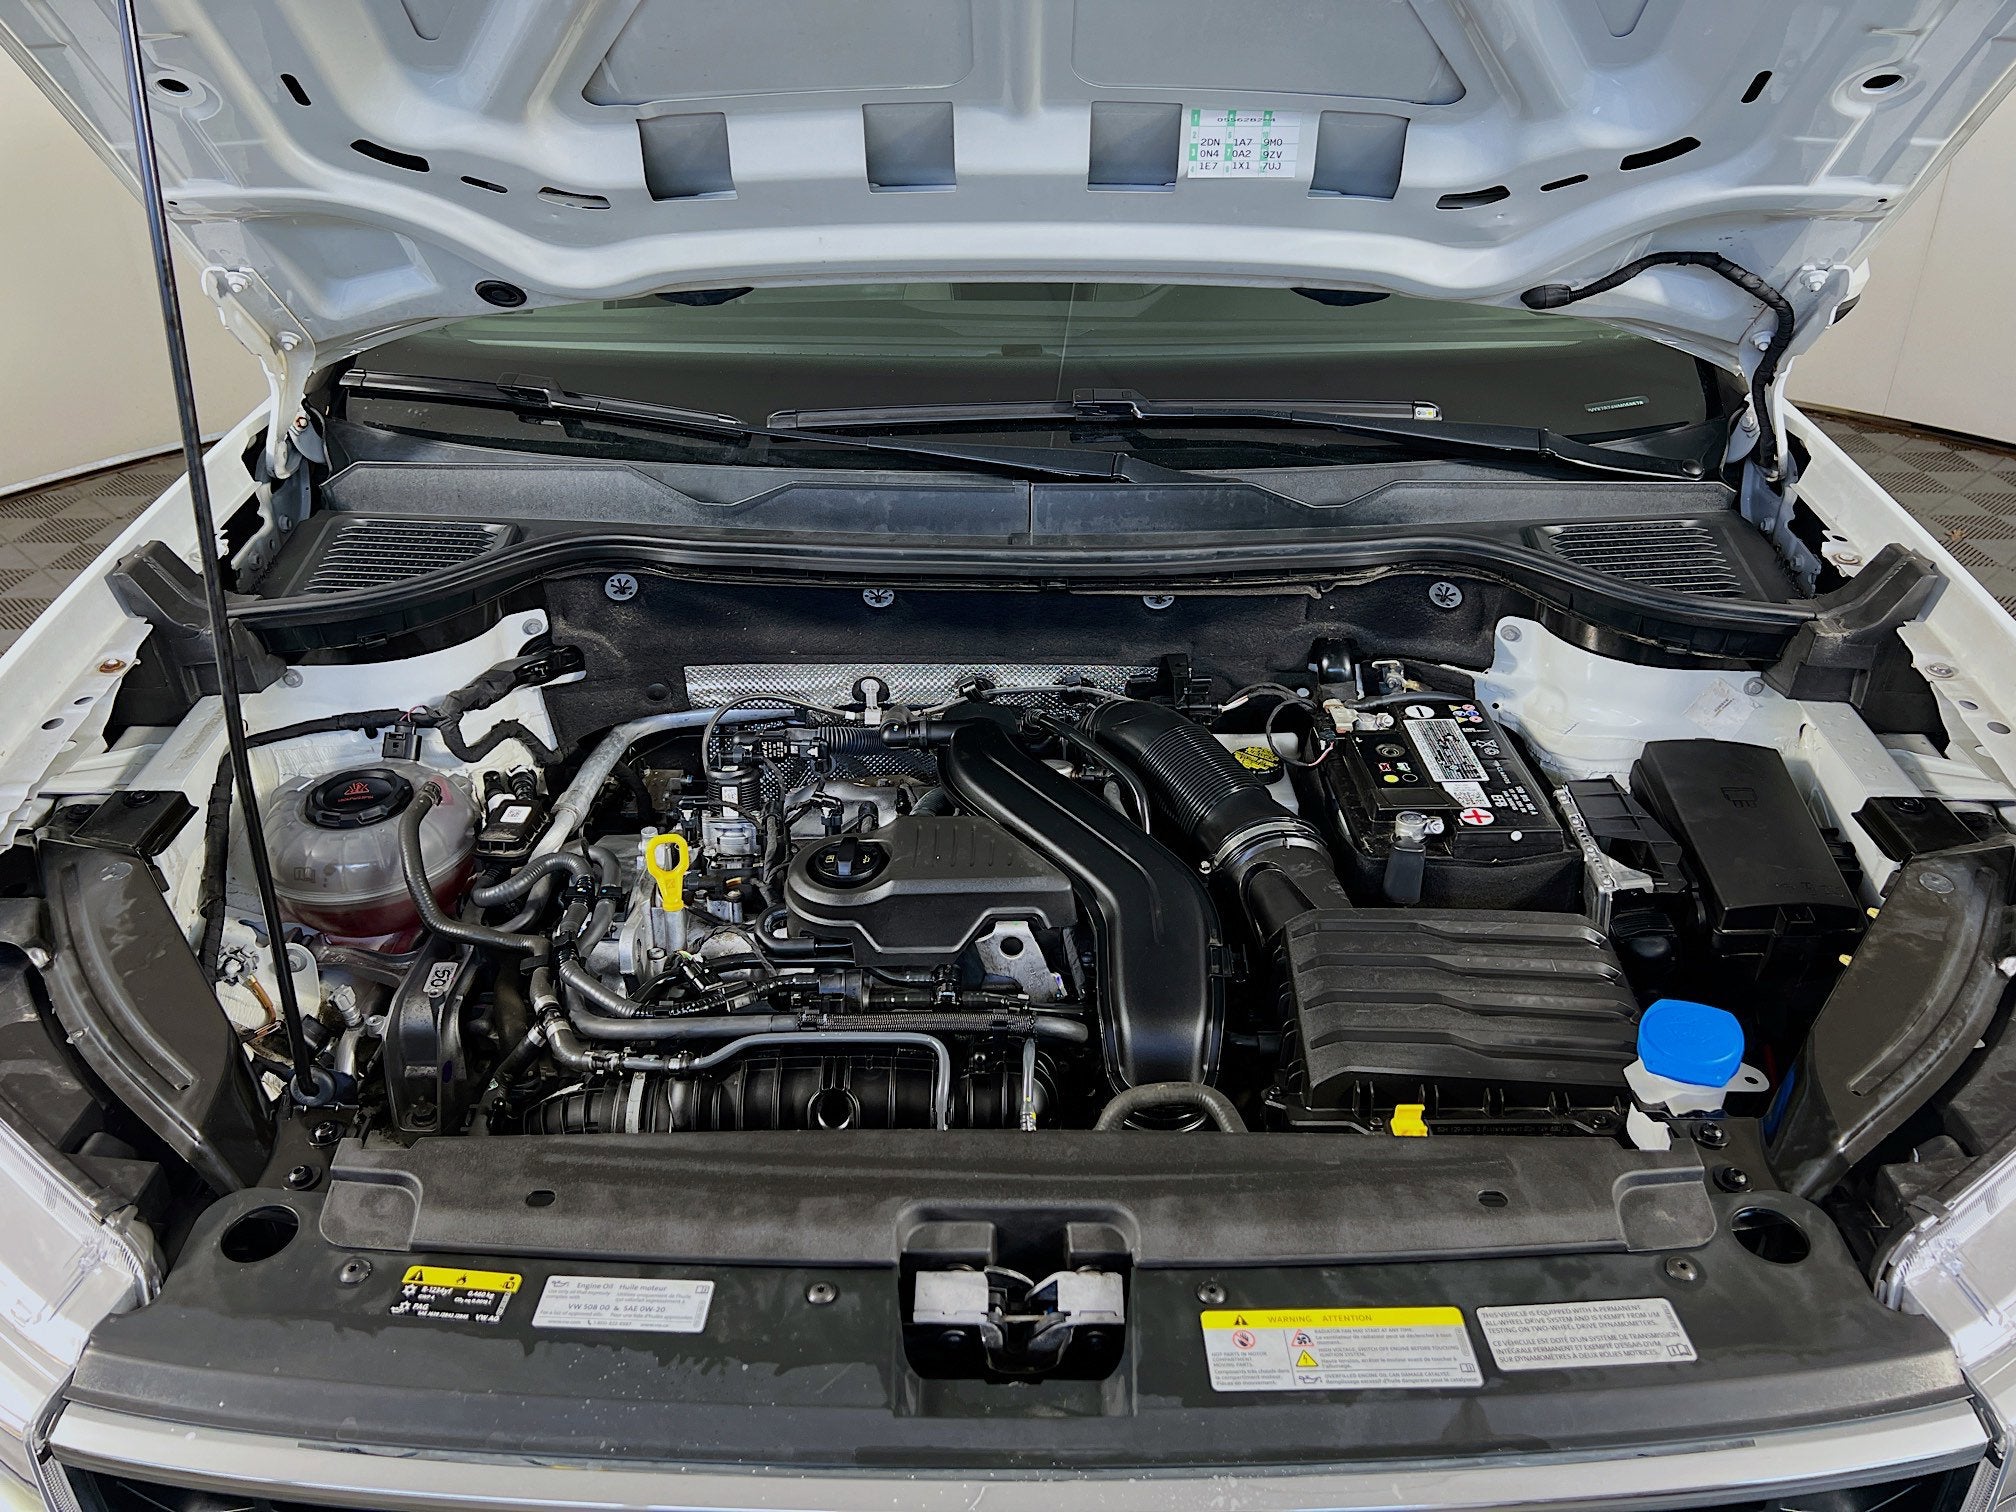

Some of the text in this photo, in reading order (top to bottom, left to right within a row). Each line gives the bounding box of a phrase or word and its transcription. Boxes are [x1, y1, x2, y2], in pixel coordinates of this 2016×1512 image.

[1234, 138, 1252, 146] 1A7
[1262, 150, 1282, 158] 9ZV
[1200, 162, 1218, 170] 1E7
[1262, 162, 1282, 170] 7UJ
[1490, 794, 1508, 808] EFB
[412, 1302, 430, 1311] PAG
[475, 1314, 488, 1322] VW
[488, 1314, 500, 1322] AG
